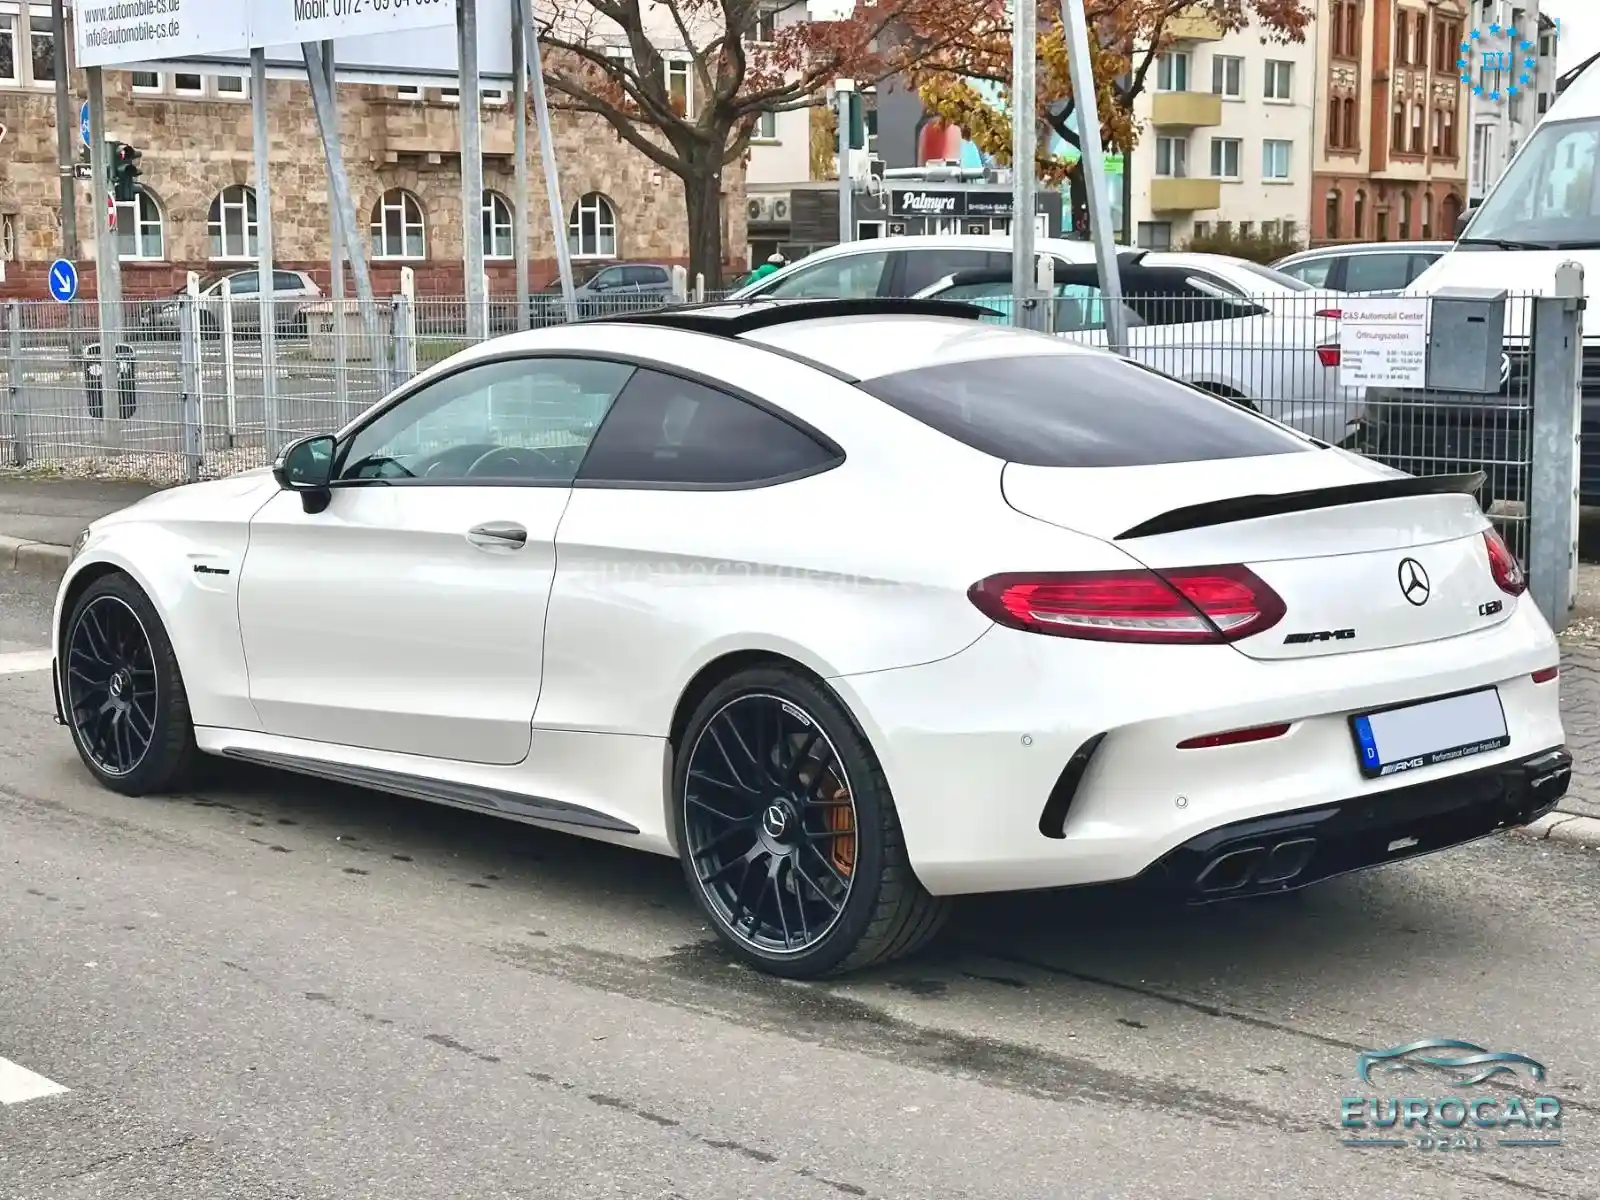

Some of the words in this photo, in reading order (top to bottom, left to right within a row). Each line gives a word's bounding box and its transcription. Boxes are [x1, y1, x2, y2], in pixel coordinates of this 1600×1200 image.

[85, 0, 179, 23] www.automobile-cs.de
[294, 0, 329, 21] Mobil:
[85, 18, 179, 48] info@automobile-cs.de
[902, 192, 955, 213] Palmyra
[1360, 312, 1398, 320] Automobil
[1399, 312, 1424, 320] Center
[1367, 747, 1375, 759] D
[1394, 757, 1424, 772] AMG
[1432, 750, 1462, 762] Performance
[1463, 745, 1479, 757] Center
[1480, 740, 1501, 753] Frankfurt
